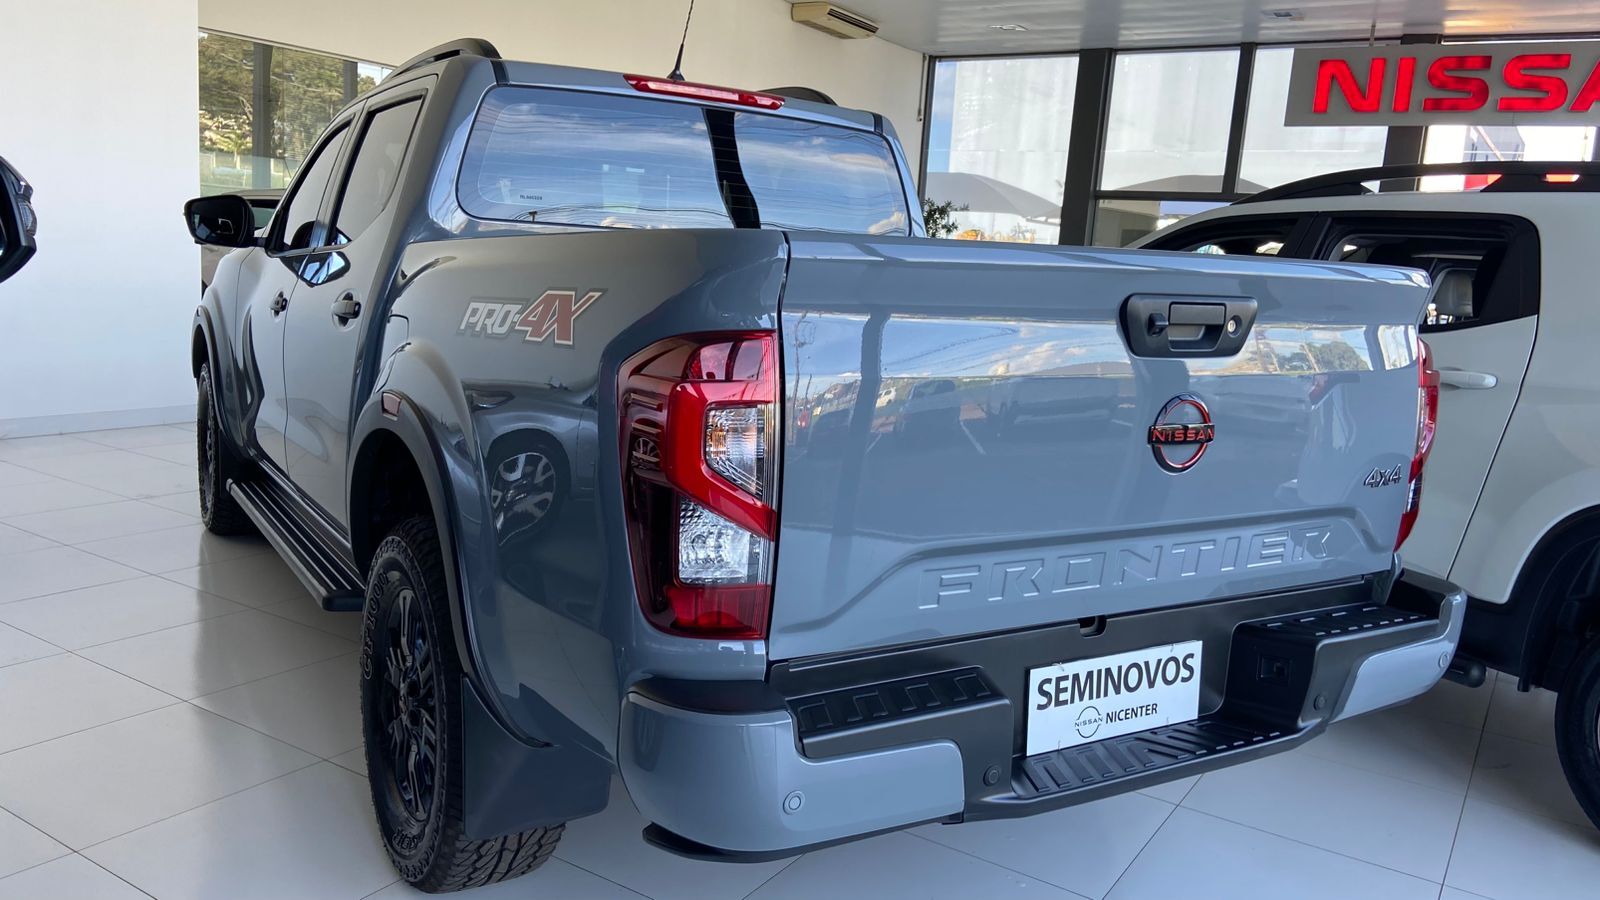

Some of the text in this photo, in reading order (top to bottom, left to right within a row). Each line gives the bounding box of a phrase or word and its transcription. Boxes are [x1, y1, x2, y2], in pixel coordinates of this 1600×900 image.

[459, 290, 603, 346] PRO-4X
[1151, 427, 1214, 442] NISSAN
[918, 524, 1332, 609] FRONTIER
[1036, 653, 1195, 711] SEMINOVOS
[1074, 703, 1158, 728] NISSAN NICENTER
